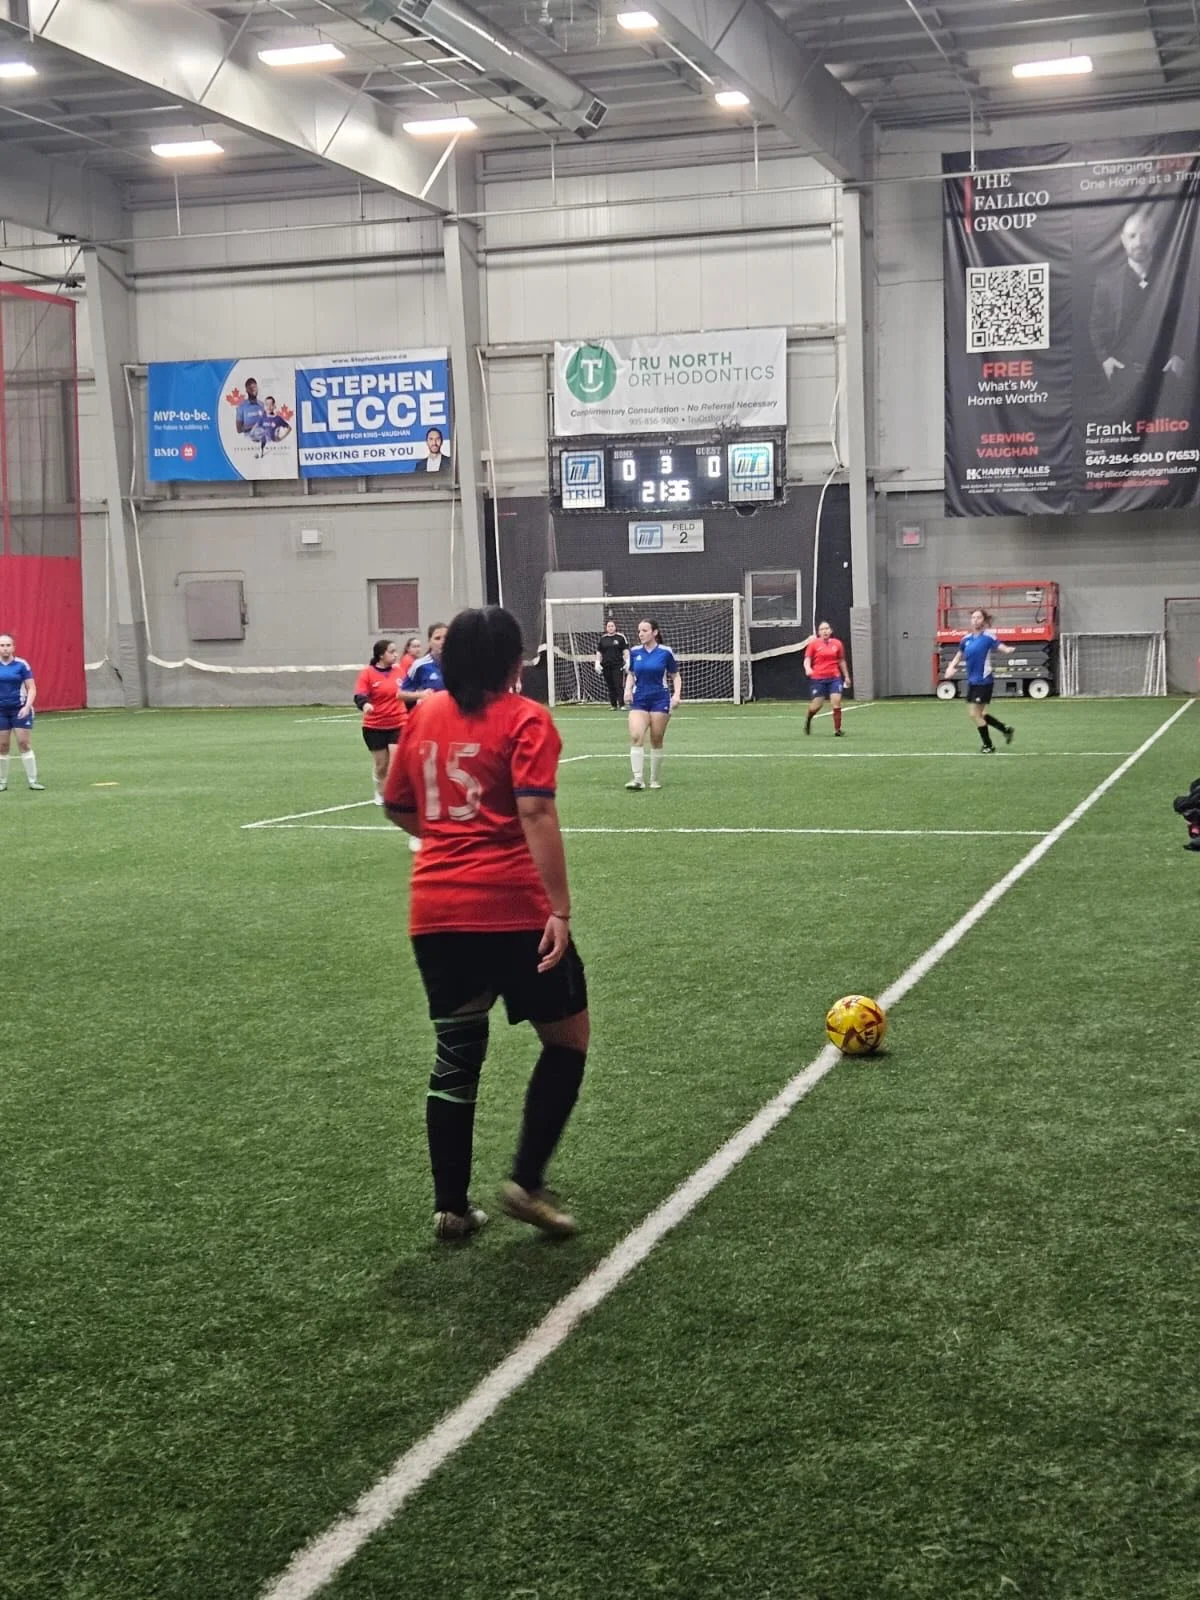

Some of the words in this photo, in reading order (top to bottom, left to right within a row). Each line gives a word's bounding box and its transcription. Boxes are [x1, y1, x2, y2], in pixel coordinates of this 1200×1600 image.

[1092, 161, 1153, 175] Changing
[973, 173, 1012, 189] THE
[1079, 178, 1105, 191] One
[1109, 175, 1146, 188] Home
[1149, 173, 1161, 184] at
[973, 191, 1049, 211] FALLICO
[973, 213, 1038, 232] GROUP
[628, 356, 660, 371] TRU
[669, 352, 732, 368] NORTH
[627, 365, 774, 388] ORTHODONTICS
[982, 361, 1034, 378] FREE
[310, 370, 433, 398] STEPHEN
[1020, 380, 1038, 391] My
[967, 396, 1003, 406] Home
[1005, 392, 1048, 404] Worth?
[301, 392, 447, 433] LECCE
[627, 405, 679, 415] Consultation
[687, 404, 699, 412] No
[701, 401, 735, 411] Referral
[736, 400, 778, 409] Necessary
[153, 409, 211, 422] MVP-to-be.
[1086, 420, 1132, 436] Frank
[1136, 418, 1190, 433] Fallico
[980, 432, 1035, 444] SERVING
[153, 448, 180, 457] BMO
[304, 450, 360, 461] WORKING
[363, 448, 386, 458] FOR
[391, 447, 414, 456] YOU
[695, 447, 722, 456] GUEST
[976, 446, 1039, 458] VAUGHAN
[1085, 451, 1164, 466] 647-254-SOLD
[1165, 449, 1199, 462] (7653)
[622, 459, 636, 481] 0
[660, 455, 672, 474] 3
[708, 455, 721, 478] 0
[981, 467, 1017, 475] HARVEY
[1018, 466, 1050, 474] KALLES
[1085, 466, 1197, 479] TheFallicoGroup@gmail.com
[565, 488, 603, 499] TRIO
[735, 482, 771, 493] TRIO
[672, 523, 695, 531] FIELD
[679, 532, 689, 544] 2
[418, 740, 483, 822] 15
